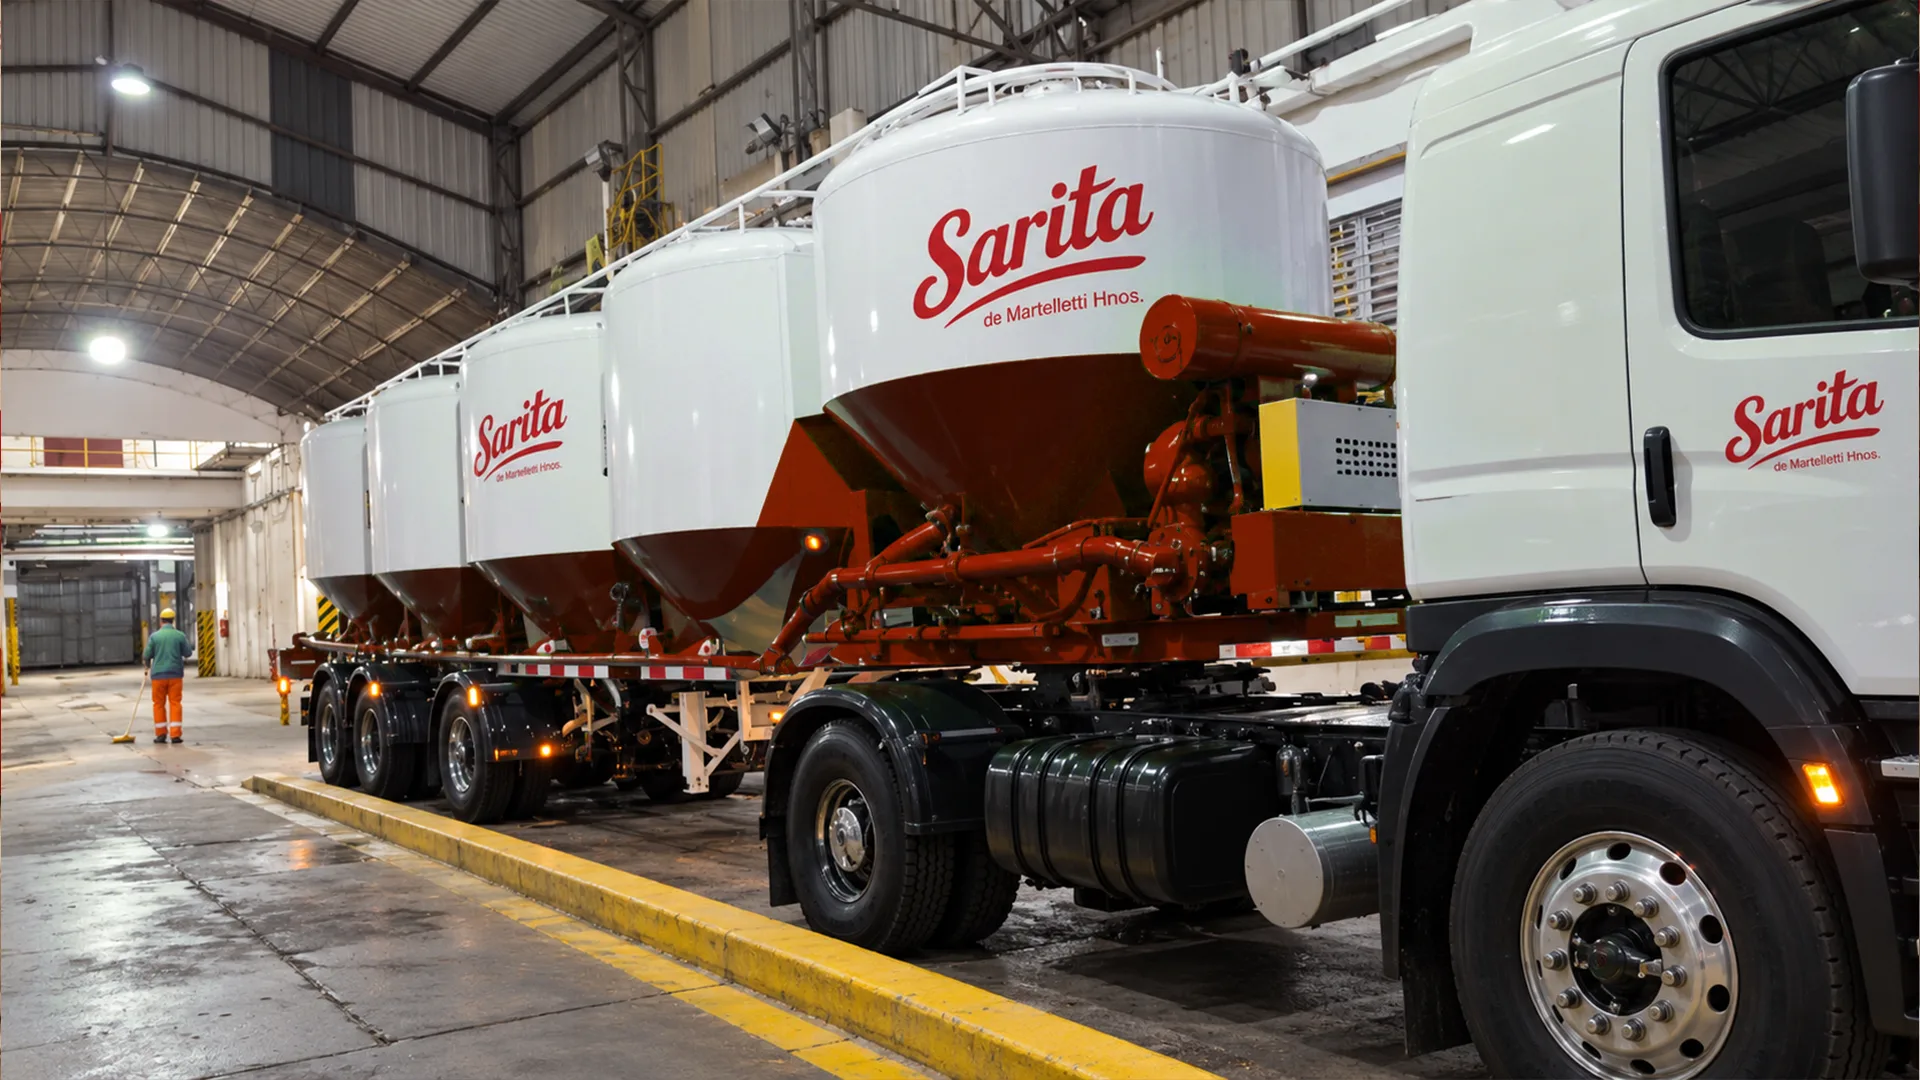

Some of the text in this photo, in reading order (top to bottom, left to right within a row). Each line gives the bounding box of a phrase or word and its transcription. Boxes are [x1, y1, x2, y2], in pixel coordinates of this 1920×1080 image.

[913, 165, 1154, 320] Sarita
[983, 291, 1144, 328] de Martelletti Hnos.
[474, 389, 568, 477] Sarita
[1725, 370, 1885, 463] Sarita
[1774, 450, 1880, 472] de Martelletti Hnos.
